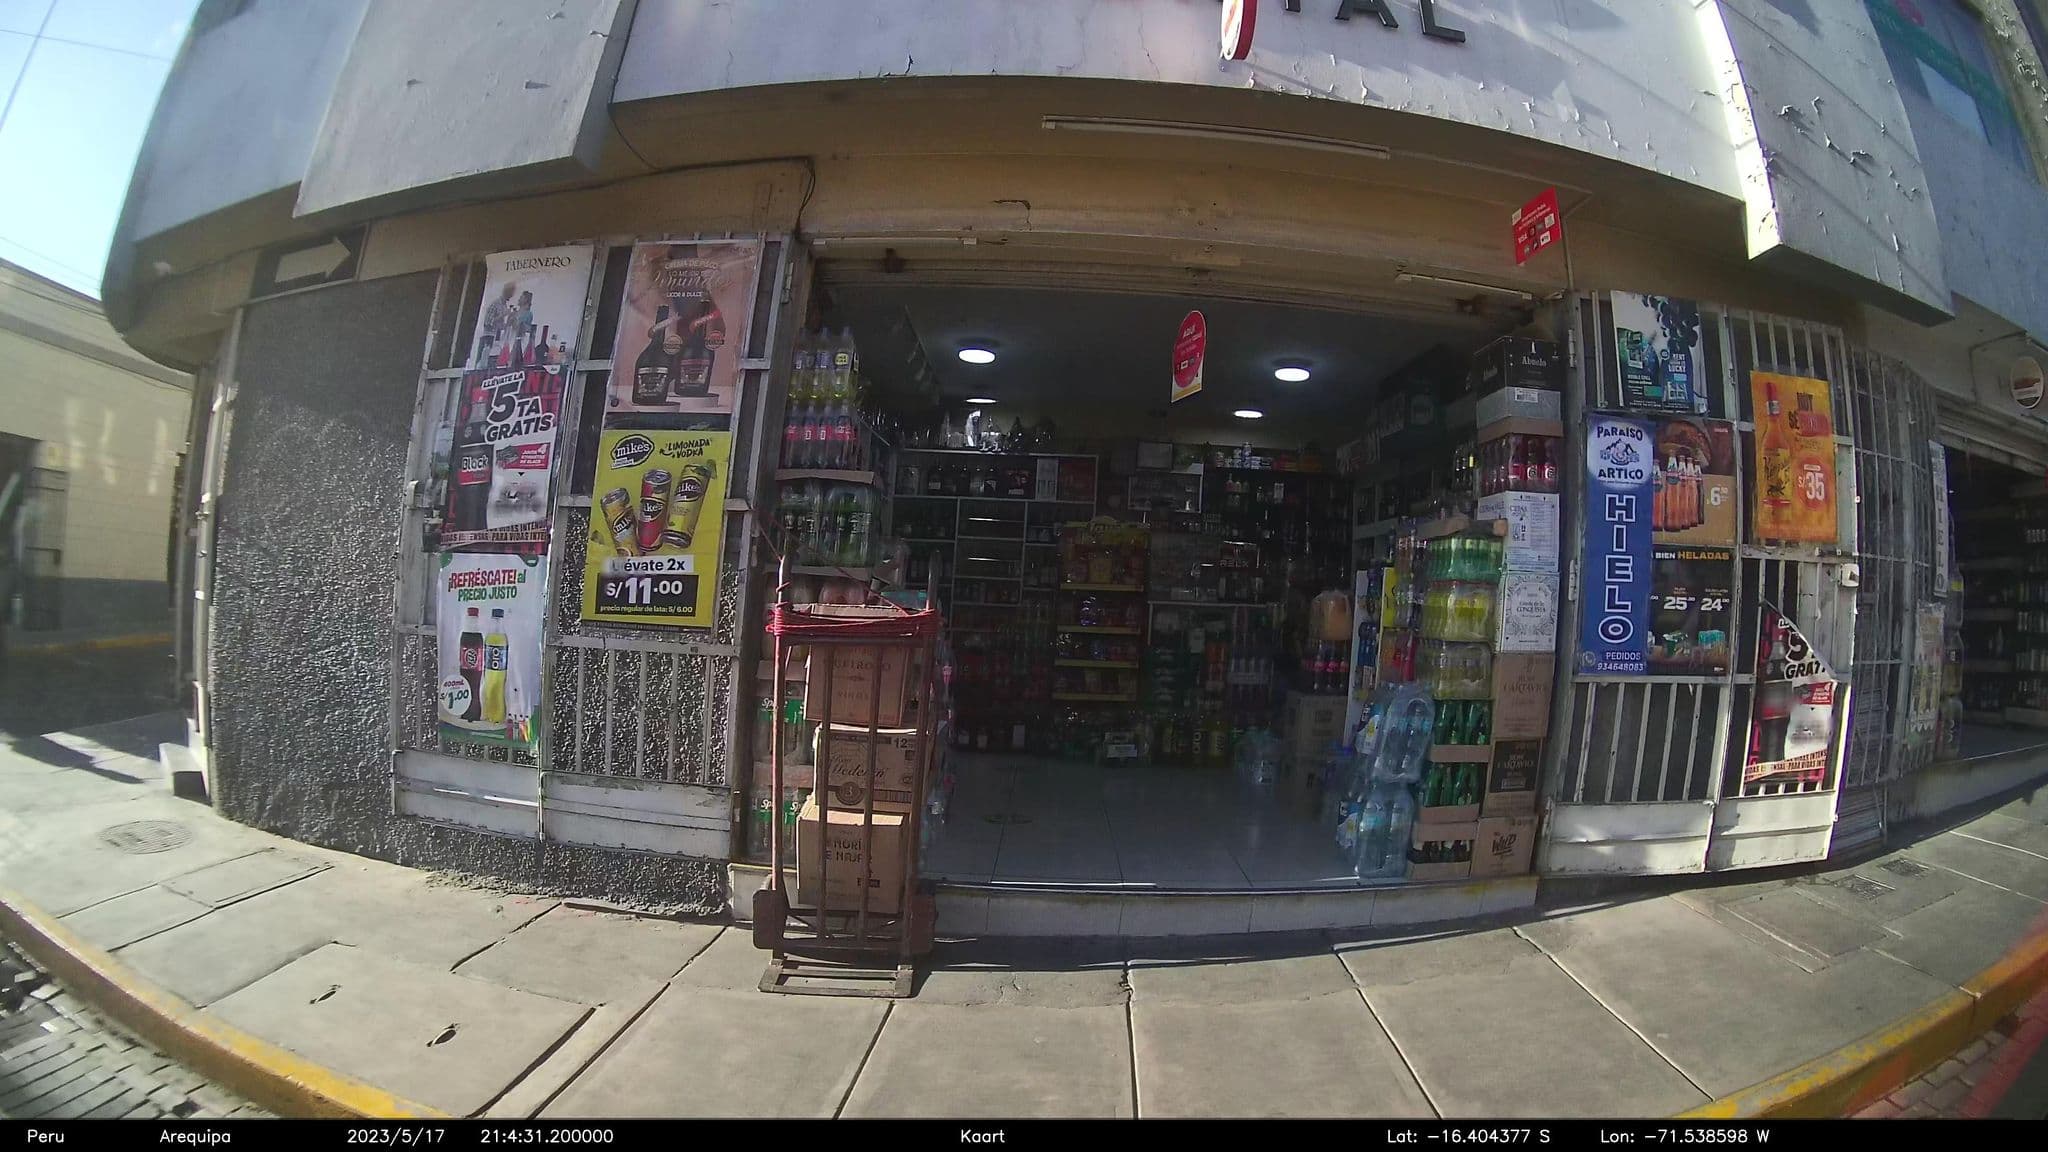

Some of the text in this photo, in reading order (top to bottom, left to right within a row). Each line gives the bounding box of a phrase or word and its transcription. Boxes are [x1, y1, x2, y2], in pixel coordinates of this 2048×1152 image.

[505, 256, 572, 272] TABERNERO
[1521, 355, 1547, 367] Abuelo
[485, 413, 553, 443] GRATIS
[615, 440, 651, 458] mike's
[667, 438, 712, 452] LIMONADA
[462, 454, 489, 473] Black
[1655, 551, 1730, 561] BIEN HELADAS
[667, 558, 685, 571] 2x
[1599, 493, 1635, 644] HIELO
[457, 586, 518, 602] PRECIO JUSTO
[1606, 651, 1641, 661] PEDIDOS
[893, 736, 908, 749] 12
